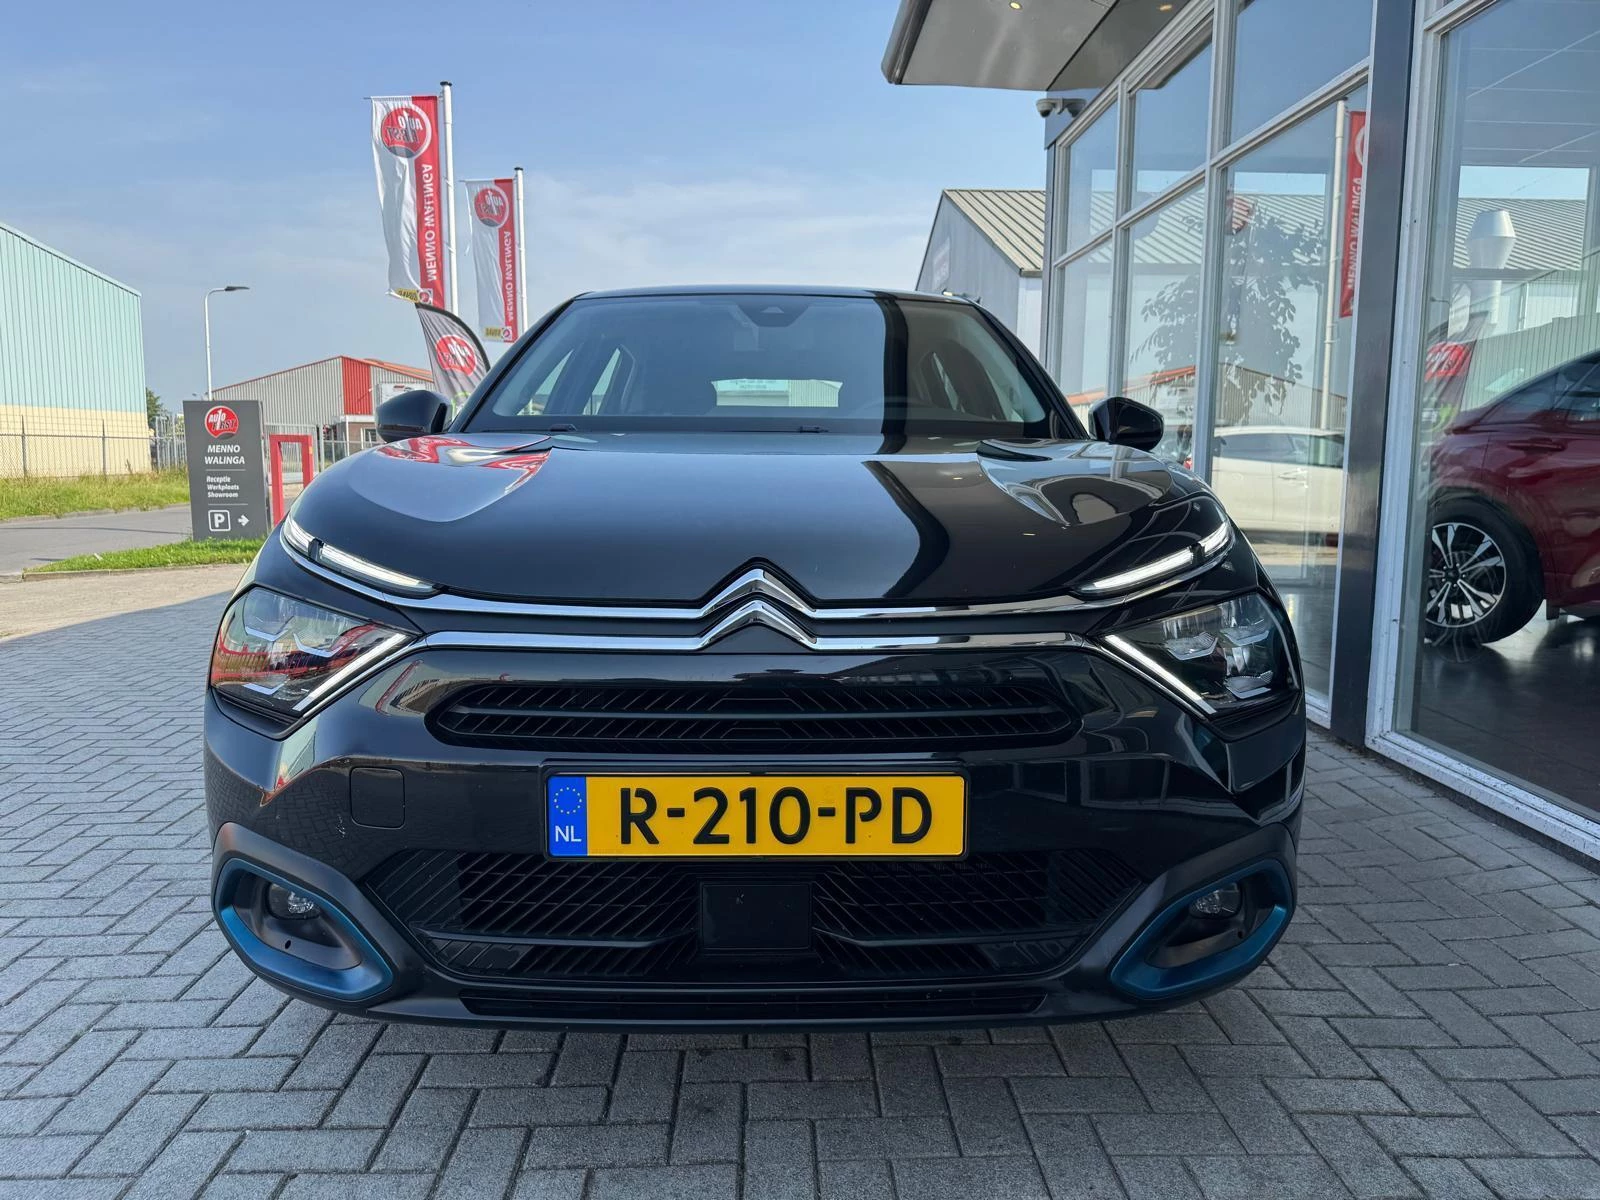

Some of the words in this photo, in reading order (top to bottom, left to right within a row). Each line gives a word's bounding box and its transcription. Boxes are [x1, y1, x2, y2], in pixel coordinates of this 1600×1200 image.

[207, 445, 241, 453] MENNO
[204, 456, 245, 465] WALINGA
[206, 475, 231, 483] Receptie
[213, 513, 225, 528] P
[620, 787, 932, 844] R-210-PD
[554, 825, 582, 842] NL
